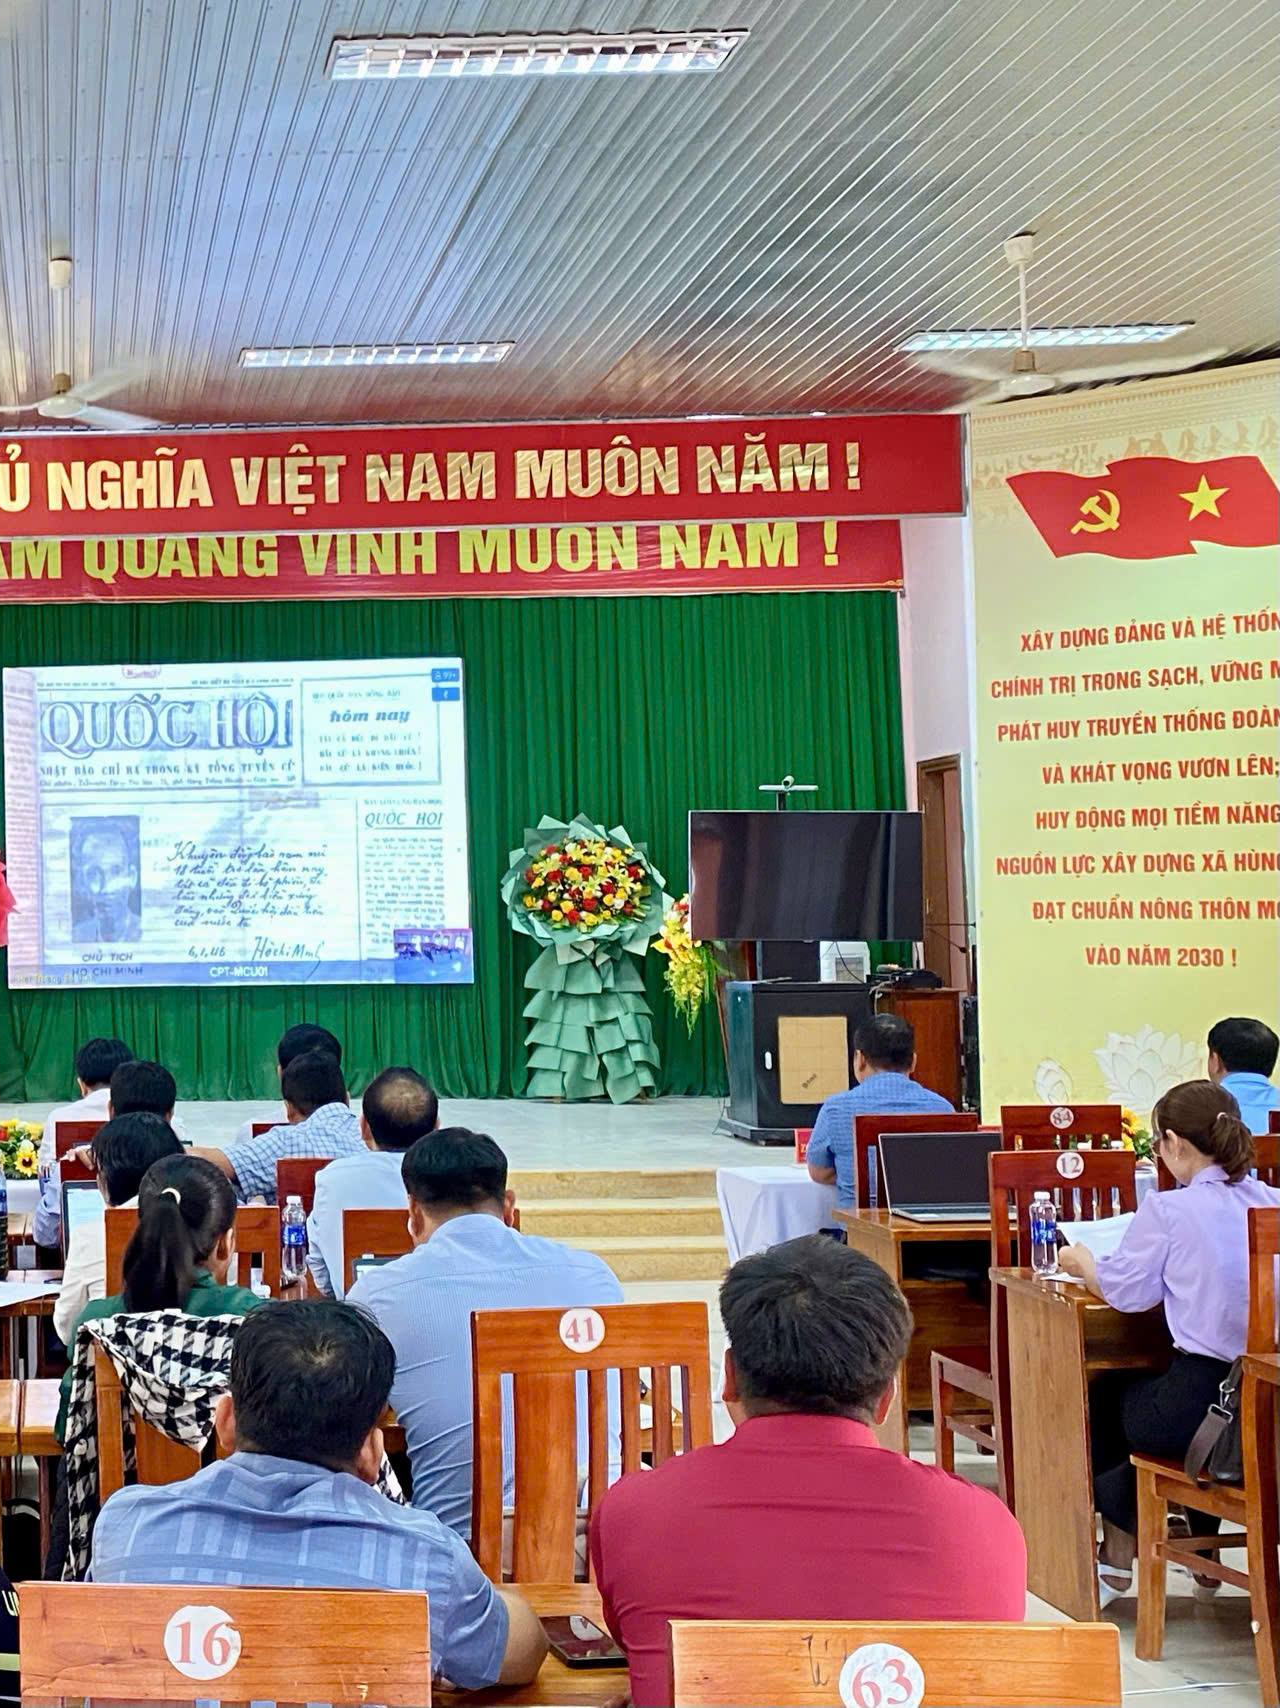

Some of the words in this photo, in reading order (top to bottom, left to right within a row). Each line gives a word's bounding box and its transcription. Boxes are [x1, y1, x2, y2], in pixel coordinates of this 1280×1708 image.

[47, 447, 214, 511] NGHĨA
[231, 443, 346, 515] VIỆT
[366, 451, 495, 503] NAM
[515, 434, 680, 499] MUÔN
[696, 432, 829, 494] NĂM
[846, 442, 861, 490] !
[83, 534, 278, 583] QUANG
[297, 531, 437, 577] VINH
[823, 520, 839, 567] !
[1021, 630, 1054, 653] XÂY
[1060, 627, 1109, 652] DỰNG
[1115, 619, 1166, 644] ĐẢNG
[1172, 616, 1196, 640] VÀ
[1202, 613, 1226, 640] HỆ
[991, 676, 1044, 698] CHÍNH
[1049, 676, 1076, 697] TRỊ
[1082, 670, 1141, 692] TRONG
[1148, 666, 1204, 691] SẠCH,
[1210, 659, 1263, 683] VỮNG
[40, 693, 198, 760] QUỐC
[208, 692, 294, 756] HỘI
[330, 709, 369, 722] hôm
[375, 709, 411, 723] nay
[997, 720, 1041, 743] PHÁT
[1047, 720, 1081, 739] HUY
[1087, 711, 1157, 737] TRUYỀN
[1163, 706, 1226, 733] THỐNG
[1042, 762, 1064, 785] VÀ
[1070, 760, 1116, 783] KHÁT
[1122, 762, 1172, 785] VỌNG
[1178, 758, 1230, 779] VƯƠN
[1236, 753, 1280, 777] LÊN;
[1036, 811, 1070, 830] HUY
[1076, 806, 1125, 833] ĐỘNG
[1132, 807, 1167, 831] MỌI
[1174, 800, 1220, 825] TIỀM
[1226, 801, 1280, 824] NĂNG
[996, 851, 1057, 875] NGUỒN
[1063, 855, 1096, 878] LỰC
[1102, 851, 1137, 874] XÂY
[1143, 852, 1195, 877] DỰNG
[1201, 850, 1228, 873] XÃ
[1234, 848, 1280, 872] HÙN
[1032, 901, 1066, 924] ĐẠT
[1071, 893, 1133, 920] CHUẨN
[1140, 897, 1193, 919] NÔNG
[1199, 897, 1250, 920] THÔN
[1085, 944, 1121, 966] VÀO
[1127, 944, 1171, 967] NĂM
[1177, 948, 1224, 967] 2030
[1232, 948, 1238, 968] !
[1060, 1156, 1081, 1174] 12
[566, 1316, 597, 1343] 41
[174, 1621, 231, 1666] 16
[852, 1658, 913, 1708] 63
